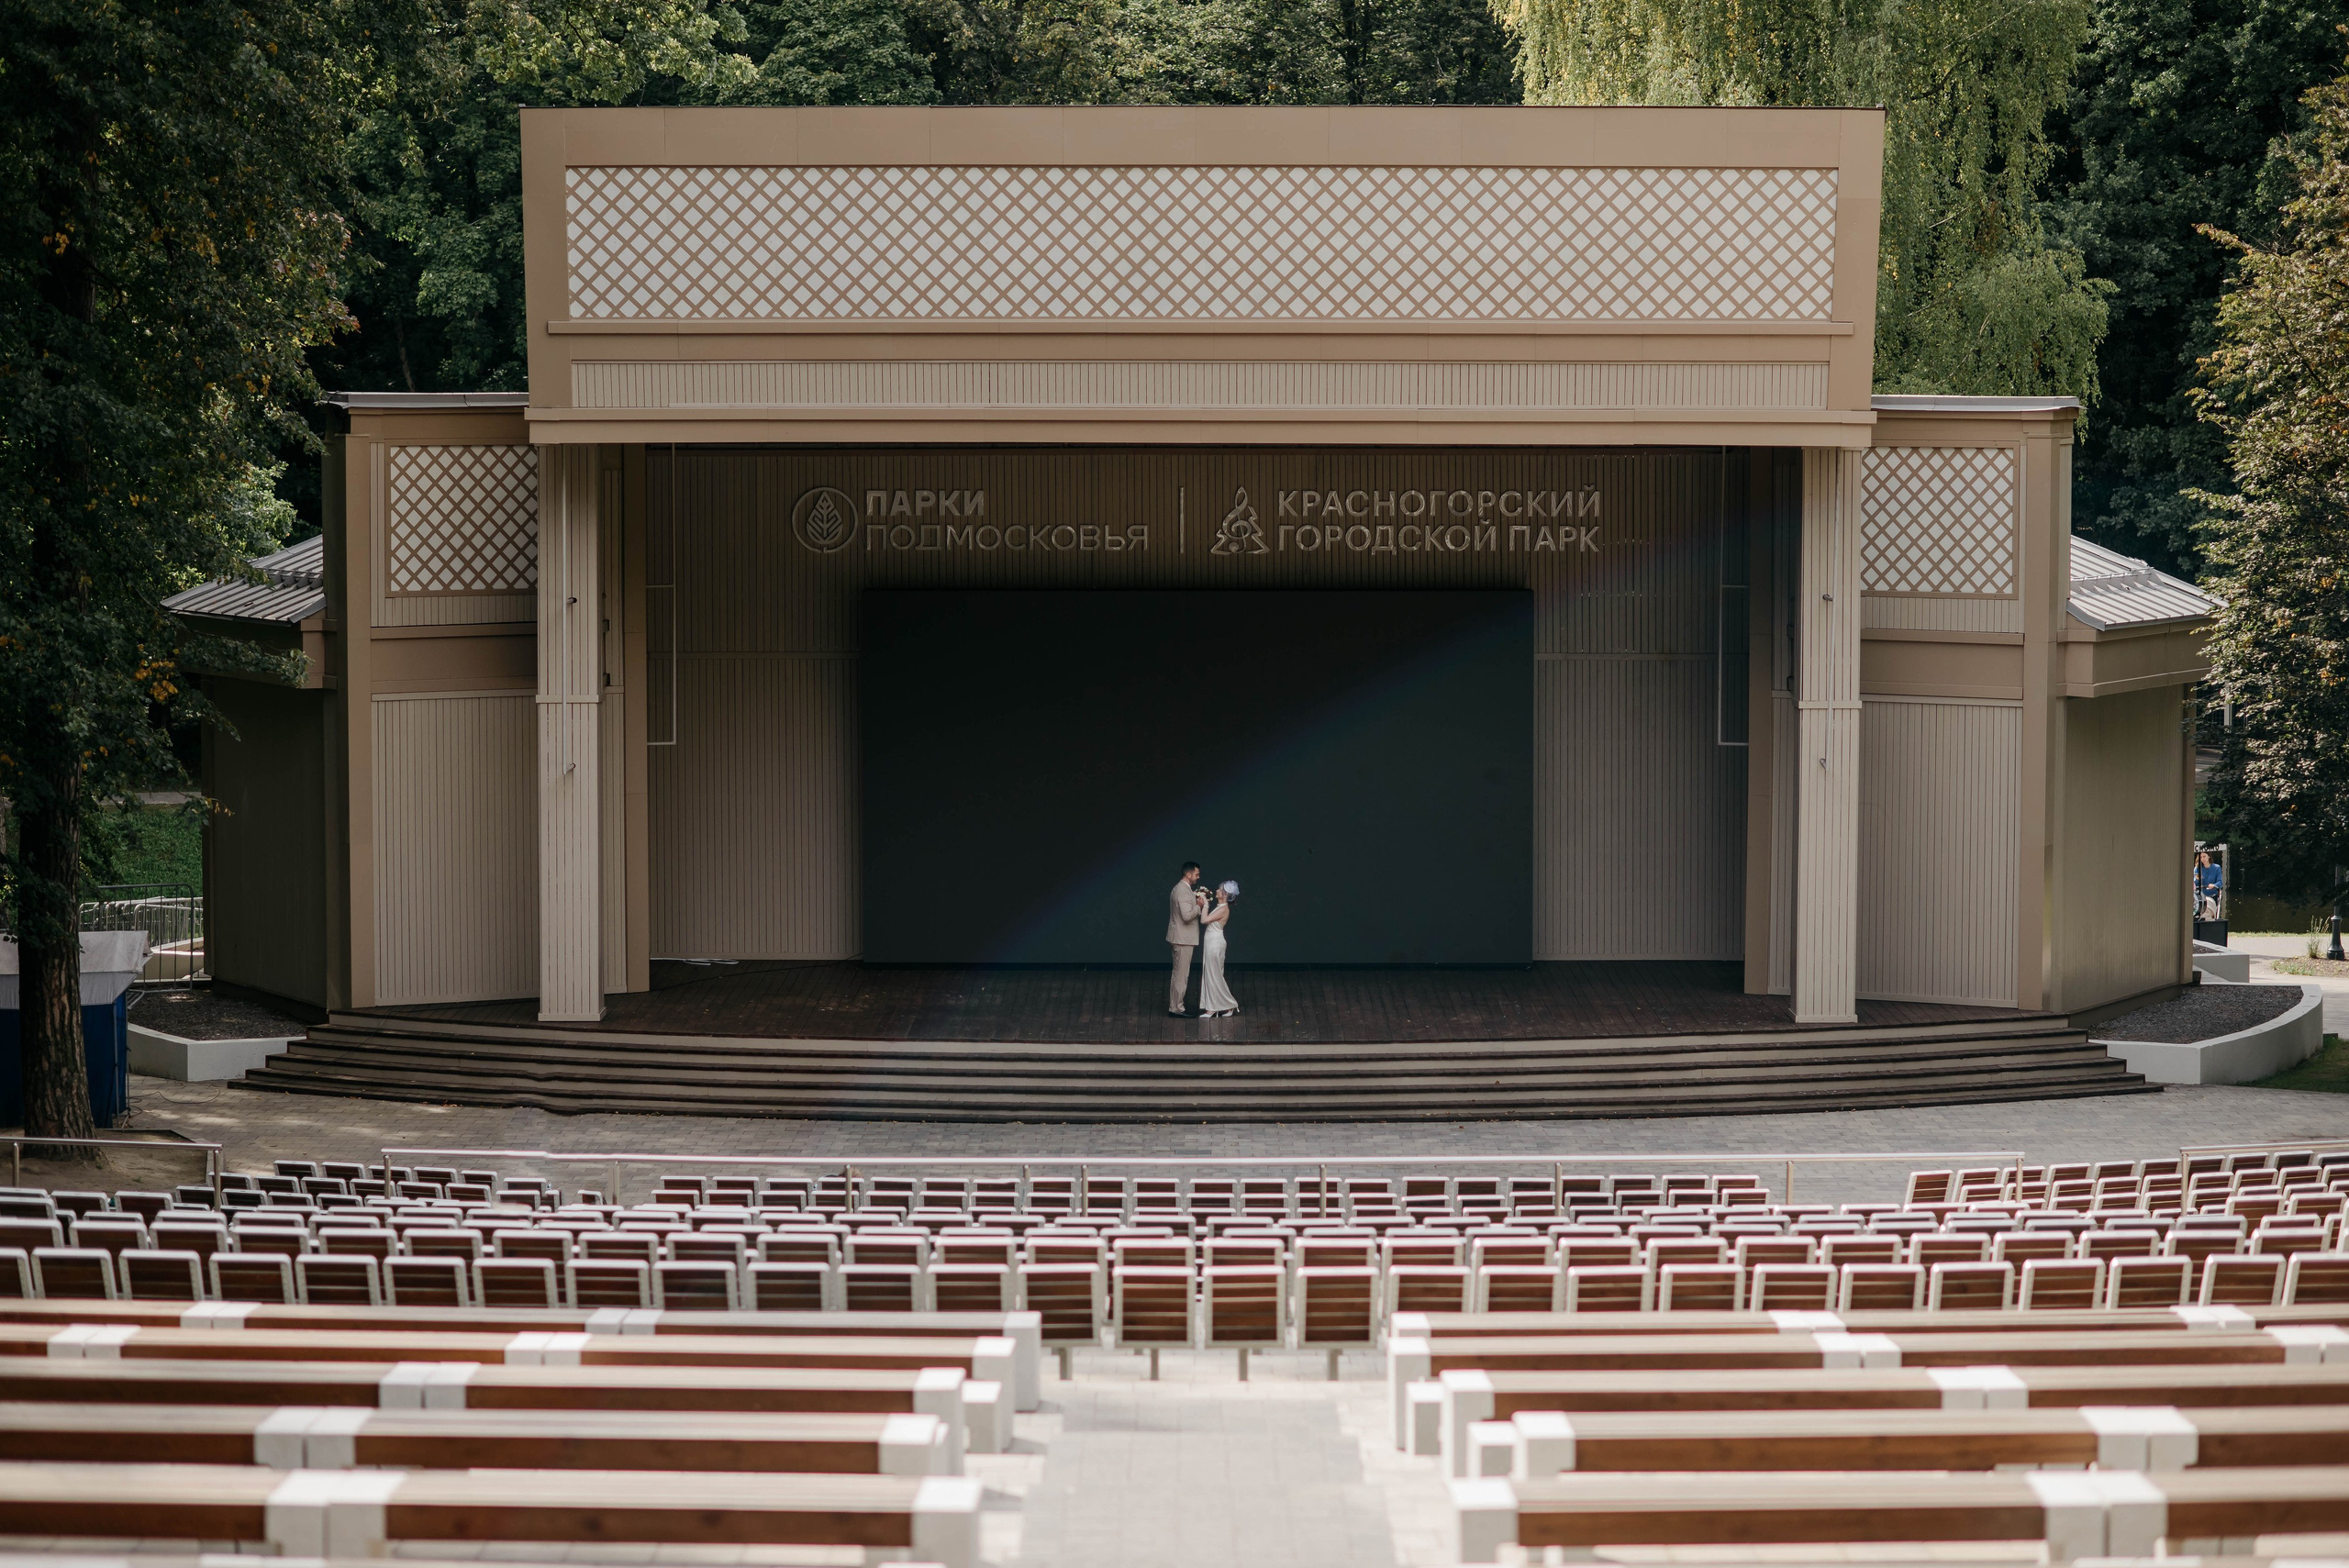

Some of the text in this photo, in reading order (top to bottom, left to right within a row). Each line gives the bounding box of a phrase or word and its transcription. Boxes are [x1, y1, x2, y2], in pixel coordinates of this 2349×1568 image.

[866, 489, 985, 517] ПАРКИ
[1277, 484, 1600, 517] КРАСНОГОРСКИЙ
[866, 524, 1148, 550] ПОДМОСКОВЬЯ
[1277, 518, 1600, 555] ГОРОДСКОЙ ПАРК
